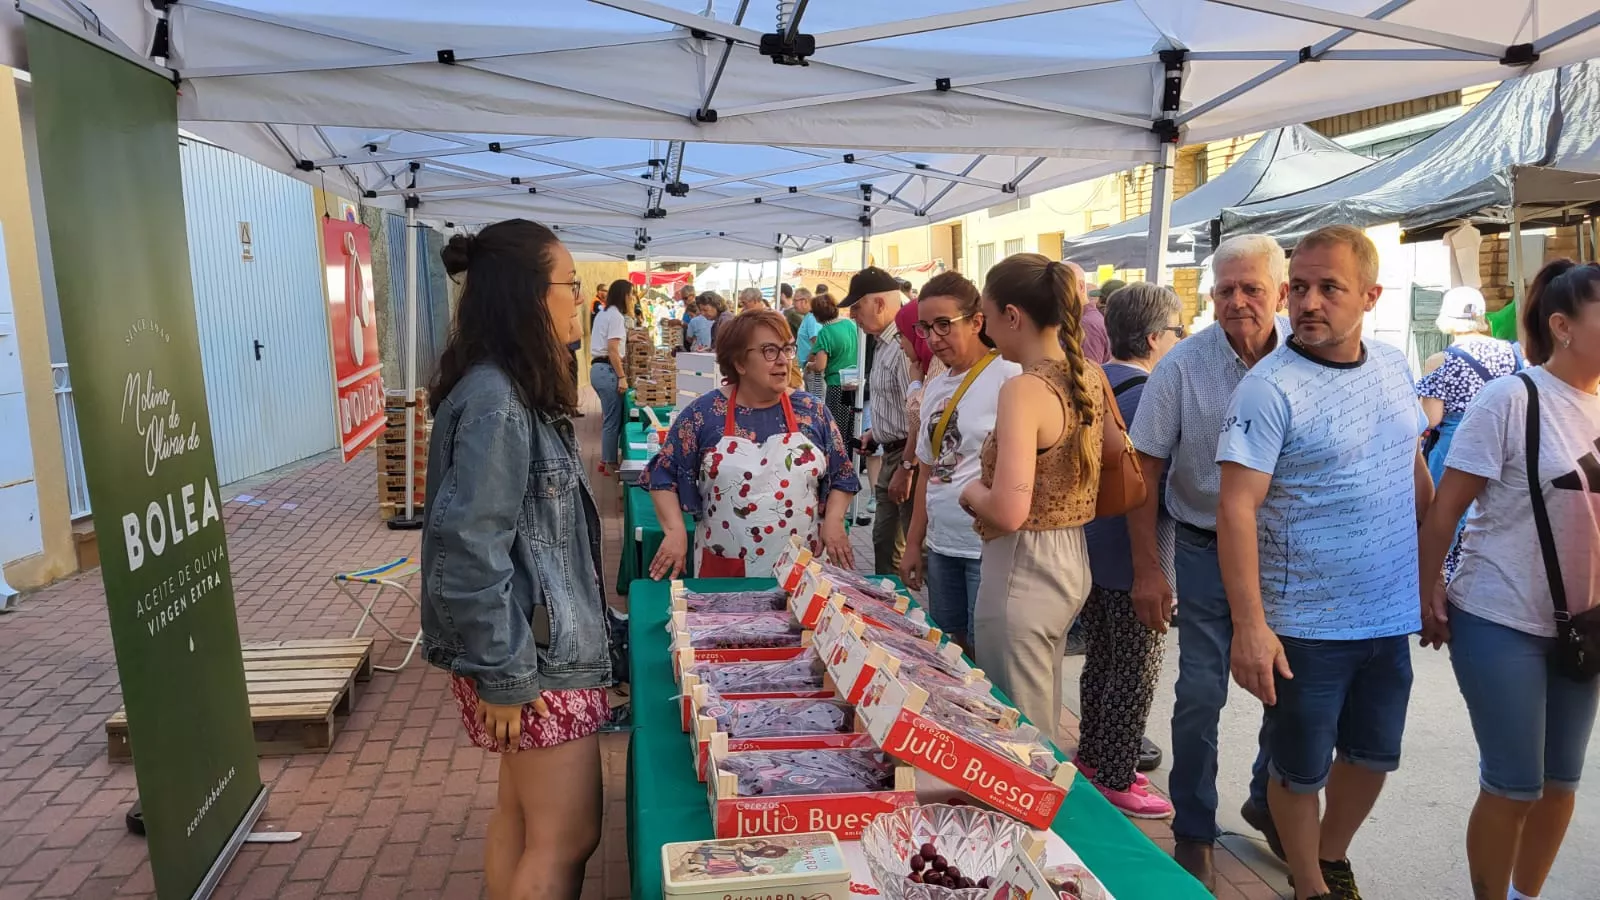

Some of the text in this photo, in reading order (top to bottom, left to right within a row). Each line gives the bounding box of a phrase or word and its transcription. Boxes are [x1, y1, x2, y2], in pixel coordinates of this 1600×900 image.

[125, 319, 149, 346] SINCE
[121, 370, 170, 436] Molino
[168, 400, 180, 429] de
[145, 415, 200, 476] Olivas de
[122, 476, 219, 572] BOLEA
[136, 544, 225, 618] ACEITE DE OLIVA
[147, 571, 221, 637] VIRGEN EXTRA
[894, 728, 958, 771] Julio
[962, 757, 1035, 811] Buesa
[736, 804, 875, 838] Julio Bues
